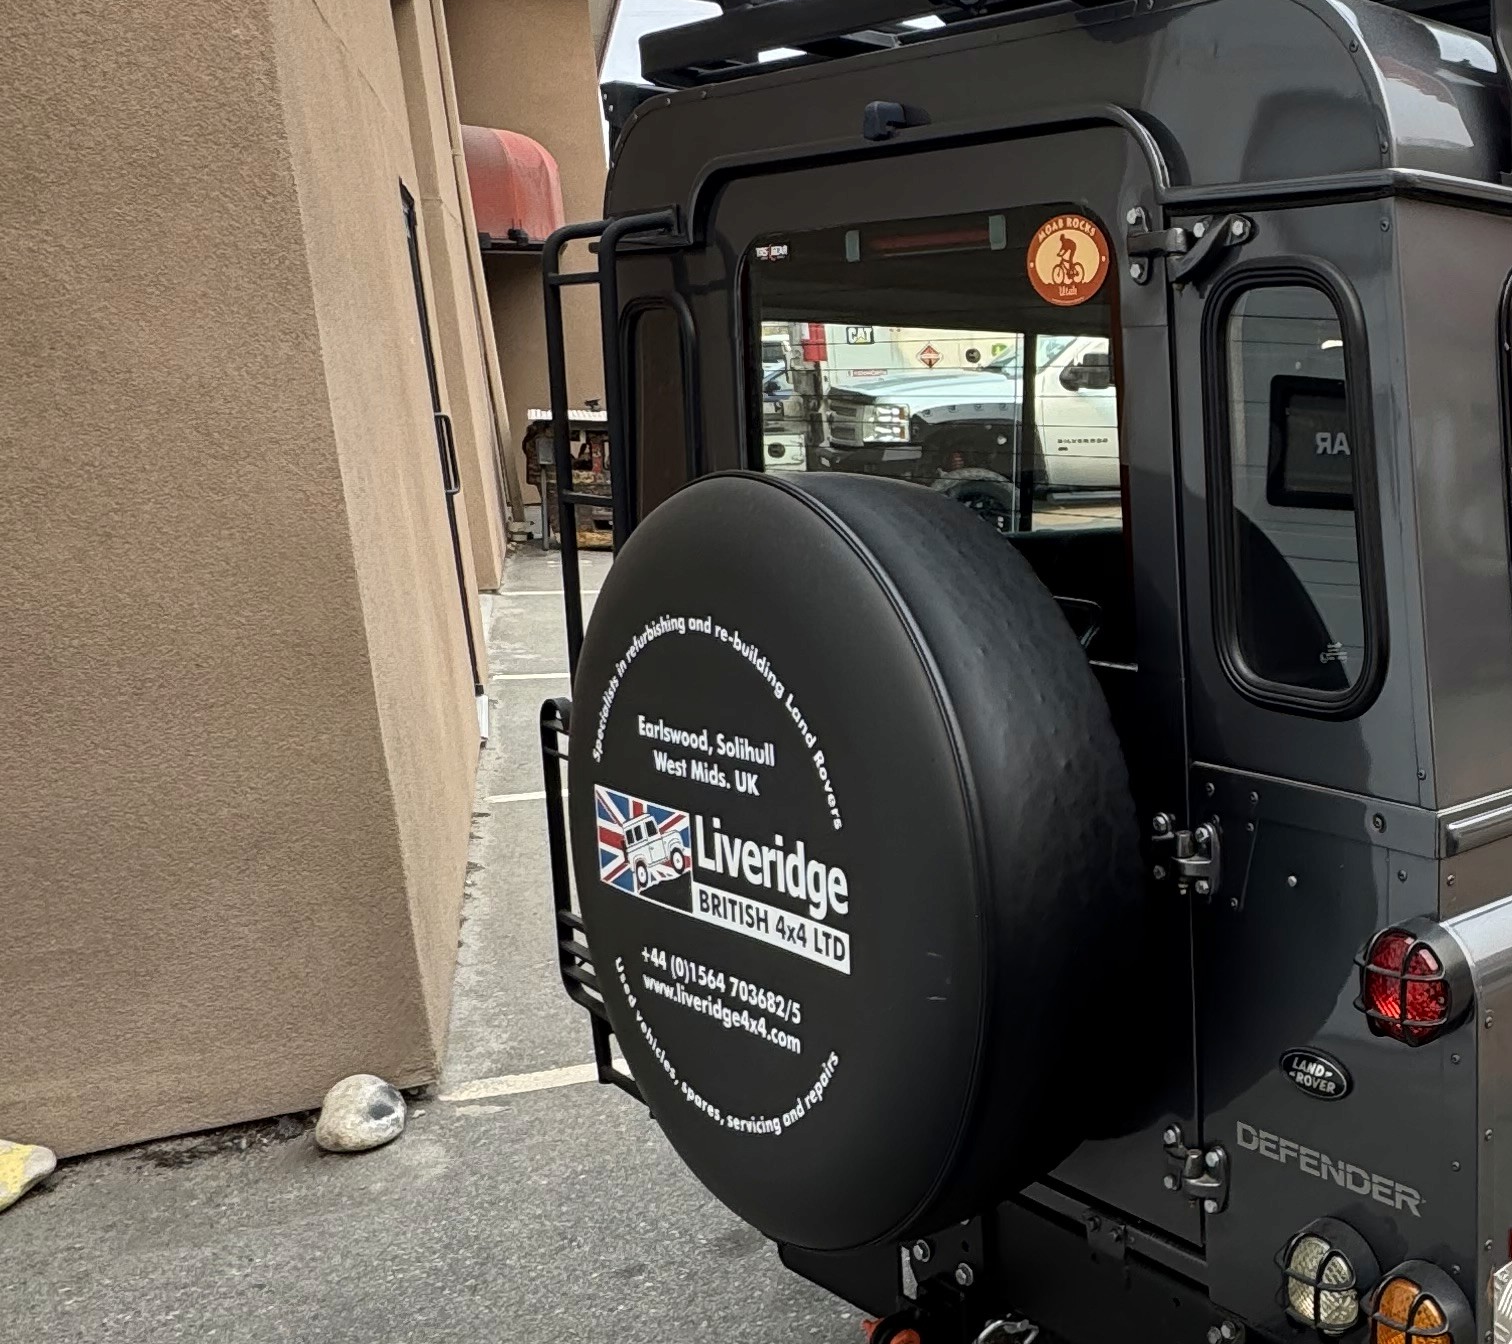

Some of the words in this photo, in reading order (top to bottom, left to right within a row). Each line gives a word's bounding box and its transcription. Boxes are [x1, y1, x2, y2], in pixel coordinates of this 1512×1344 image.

[1038, 218, 1064, 243] MOAB
[1066, 217, 1096, 237] ROCKS
[1058, 284, 1078, 297] Utah
[847, 327, 874, 344] CAT
[592, 675, 620, 764] Specialists
[615, 659, 628, 678] in
[625, 614, 686, 664] refurbishing
[687, 615, 712, 635] and
[714, 624, 785, 699] re-building
[785, 693, 817, 749] Land
[812, 749, 843, 831] Rovers
[638, 714, 714, 756] Earlswood,
[716, 732, 775, 767] Solihull
[653, 749, 687, 778] West
[690, 759, 731, 789] Mids.
[734, 769, 760, 796] UK
[695, 814, 849, 921] Liveridge
[699, 888, 770, 934] BRITISH
[775, 914, 807, 948] 4x4
[813, 927, 846, 962] LTD
[641, 946, 667, 971] +44
[670, 954, 726, 993] (0)1564
[729, 976, 801, 1024] 703682/5
[642, 973, 801, 1054] www.liveridge4x4.com
[615, 957, 637, 1008] Used
[636, 1009, 679, 1086] vehicles,
[681, 1081, 725, 1126] spares,
[726, 1115, 782, 1136] servicing
[782, 1097, 805, 1127] and
[804, 1051, 839, 1110] repairs
[1292, 1057, 1325, 1078] LAND
[1295, 1071, 1336, 1095] ROVER
[1236, 1120, 1422, 1218] DEFENDER
